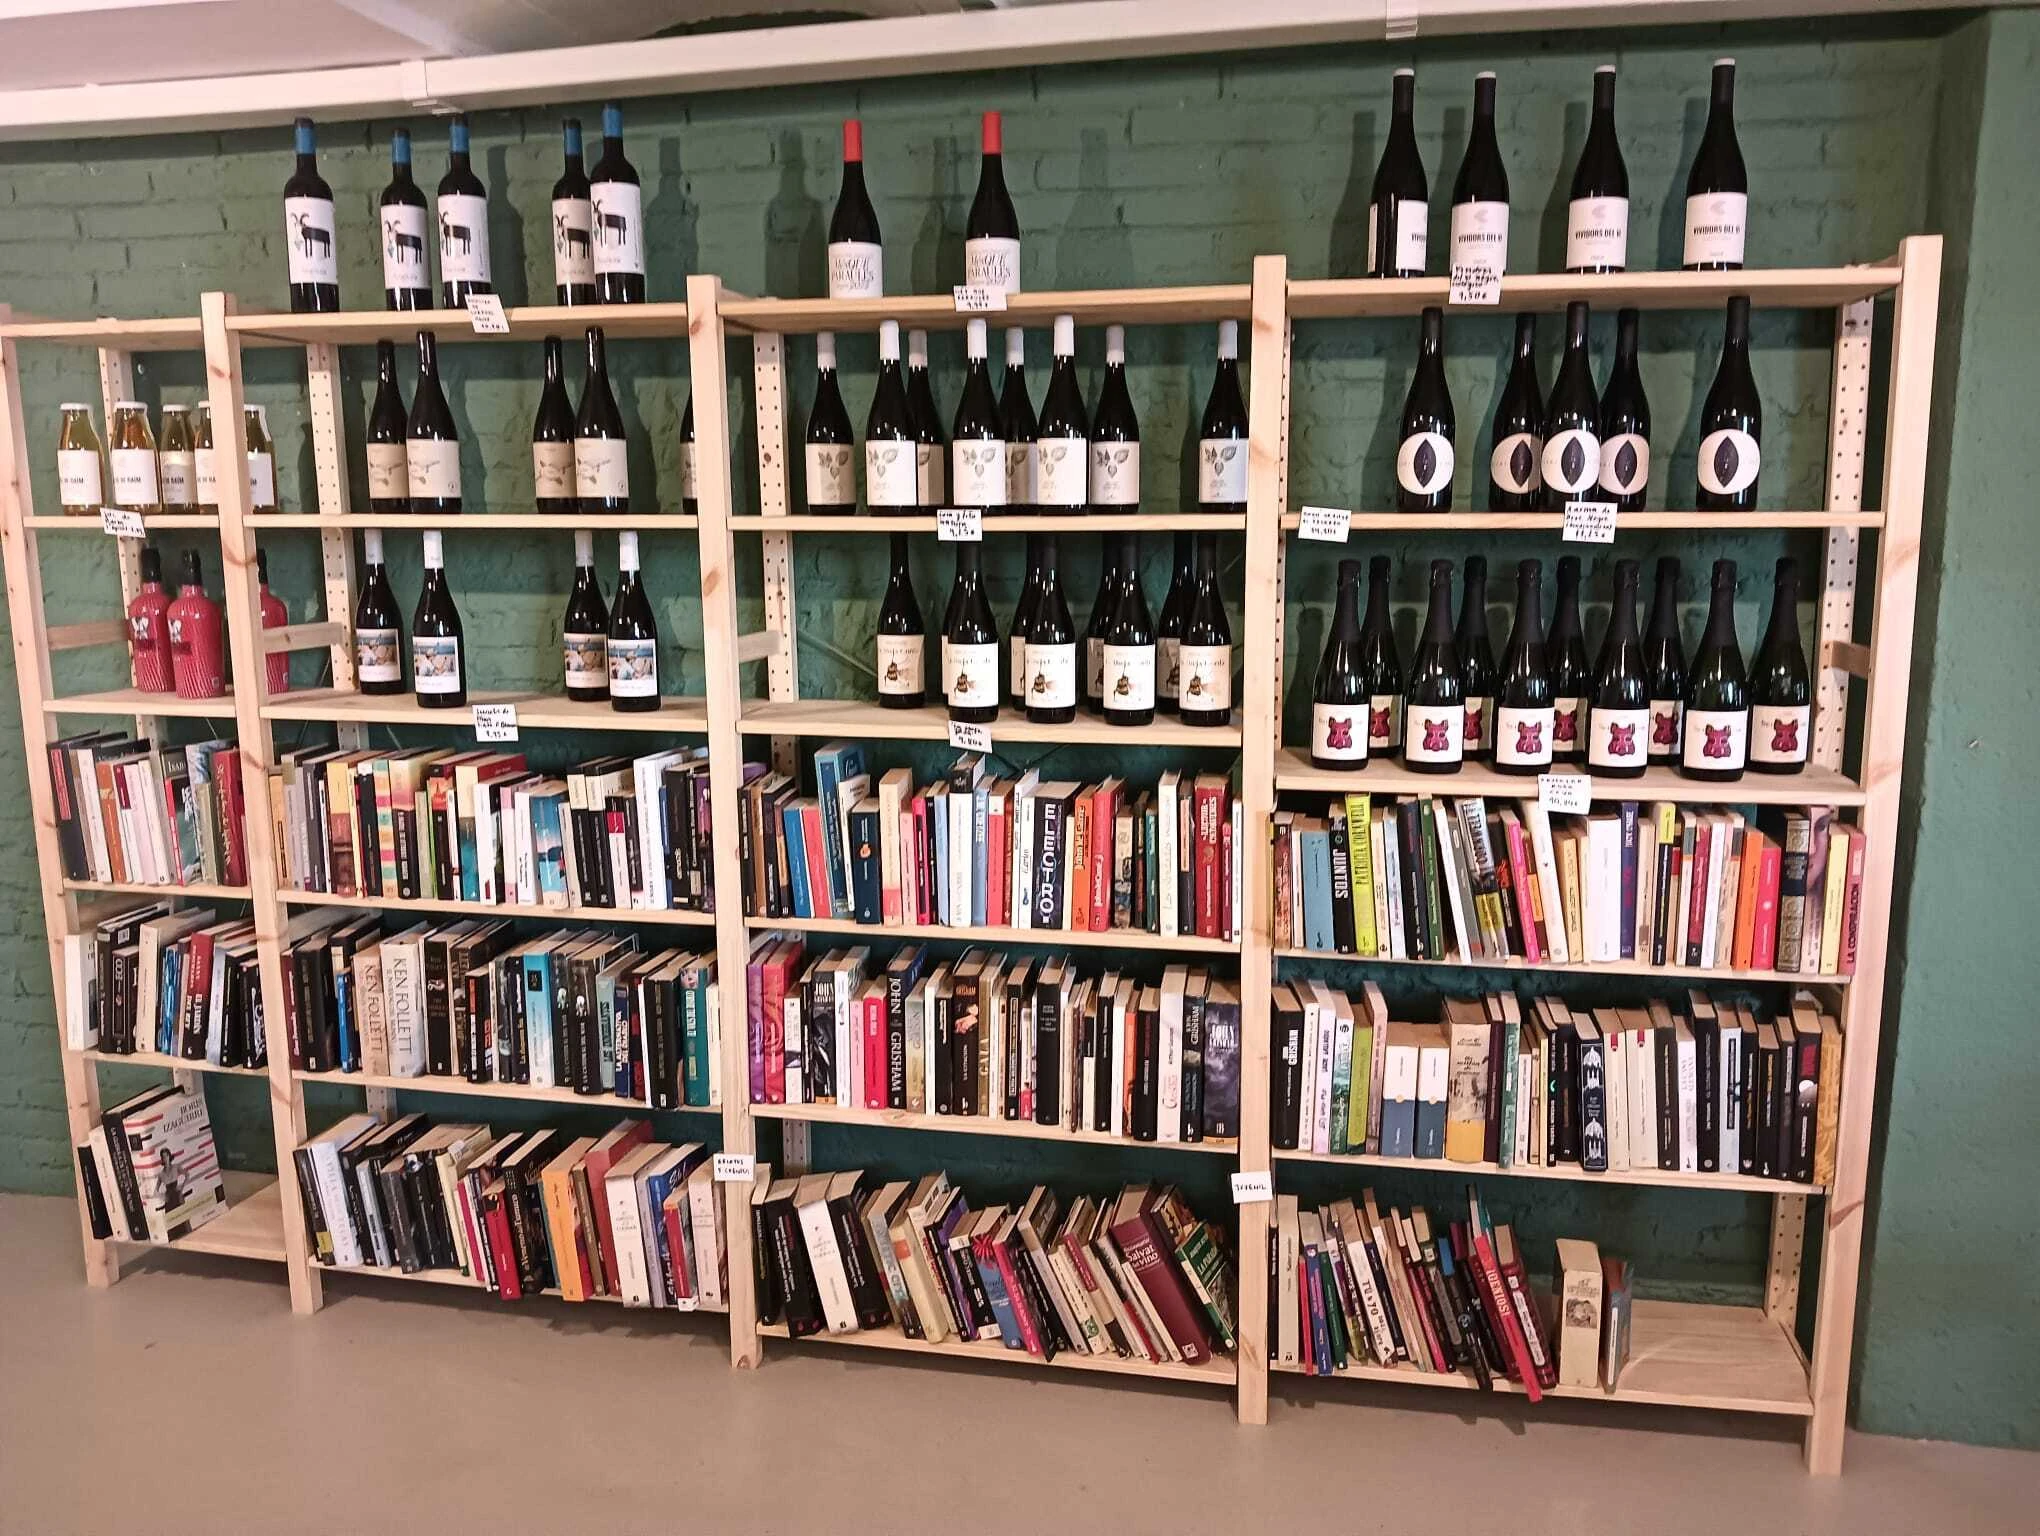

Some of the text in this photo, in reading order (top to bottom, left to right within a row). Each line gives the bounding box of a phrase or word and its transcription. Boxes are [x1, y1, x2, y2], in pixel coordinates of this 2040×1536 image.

[1332, 848, 1349, 899] JUNTOS
[364, 964, 383, 1053] KEN FOLLETT
[392, 958, 413, 1055] KEN FOLLETT
[888, 978, 902, 1092] JOHN GRISHAM
[1125, 1244, 1154, 1264] Salvat
[1138, 1252, 1160, 1266] vino
